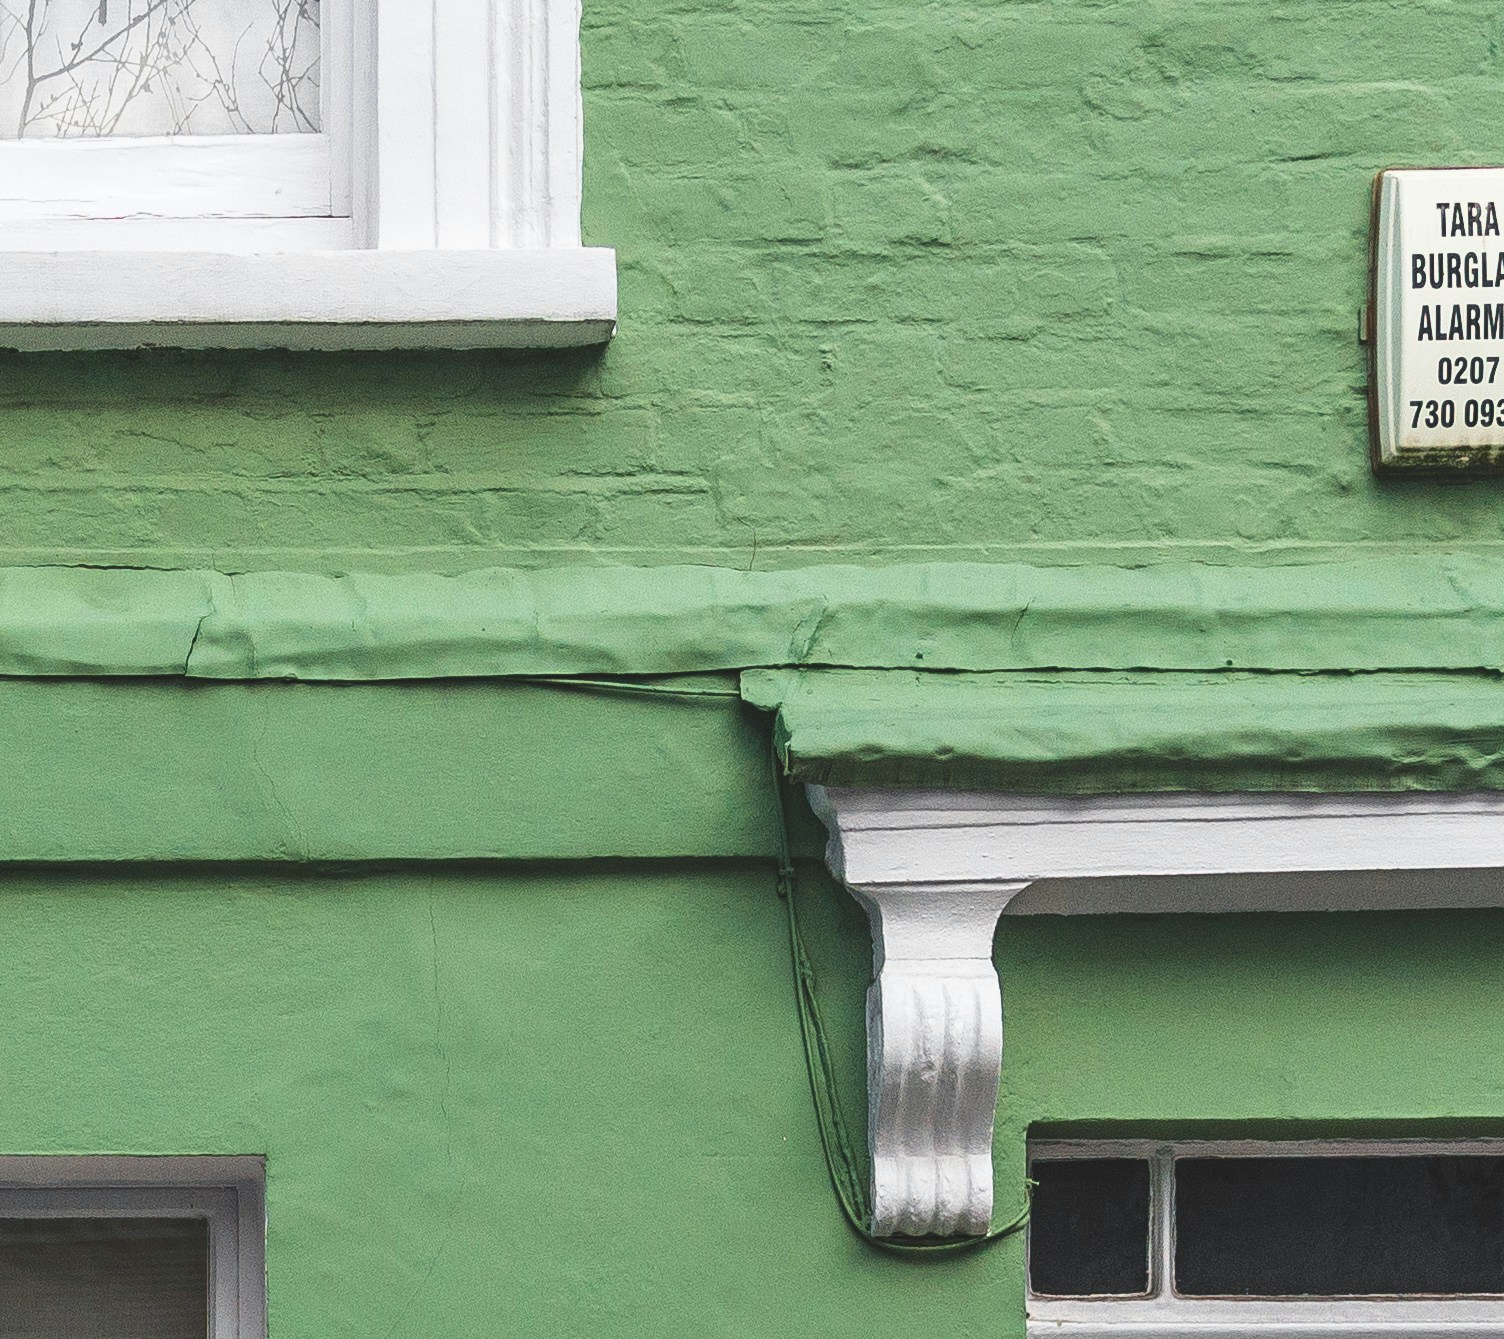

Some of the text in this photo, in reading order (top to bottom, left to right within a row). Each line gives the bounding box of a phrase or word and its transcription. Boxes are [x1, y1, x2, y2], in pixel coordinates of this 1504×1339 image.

[1436, 201, 1500, 238] TARA
[1437, 356, 1500, 385] 0207
[1409, 400, 1455, 429] 730
